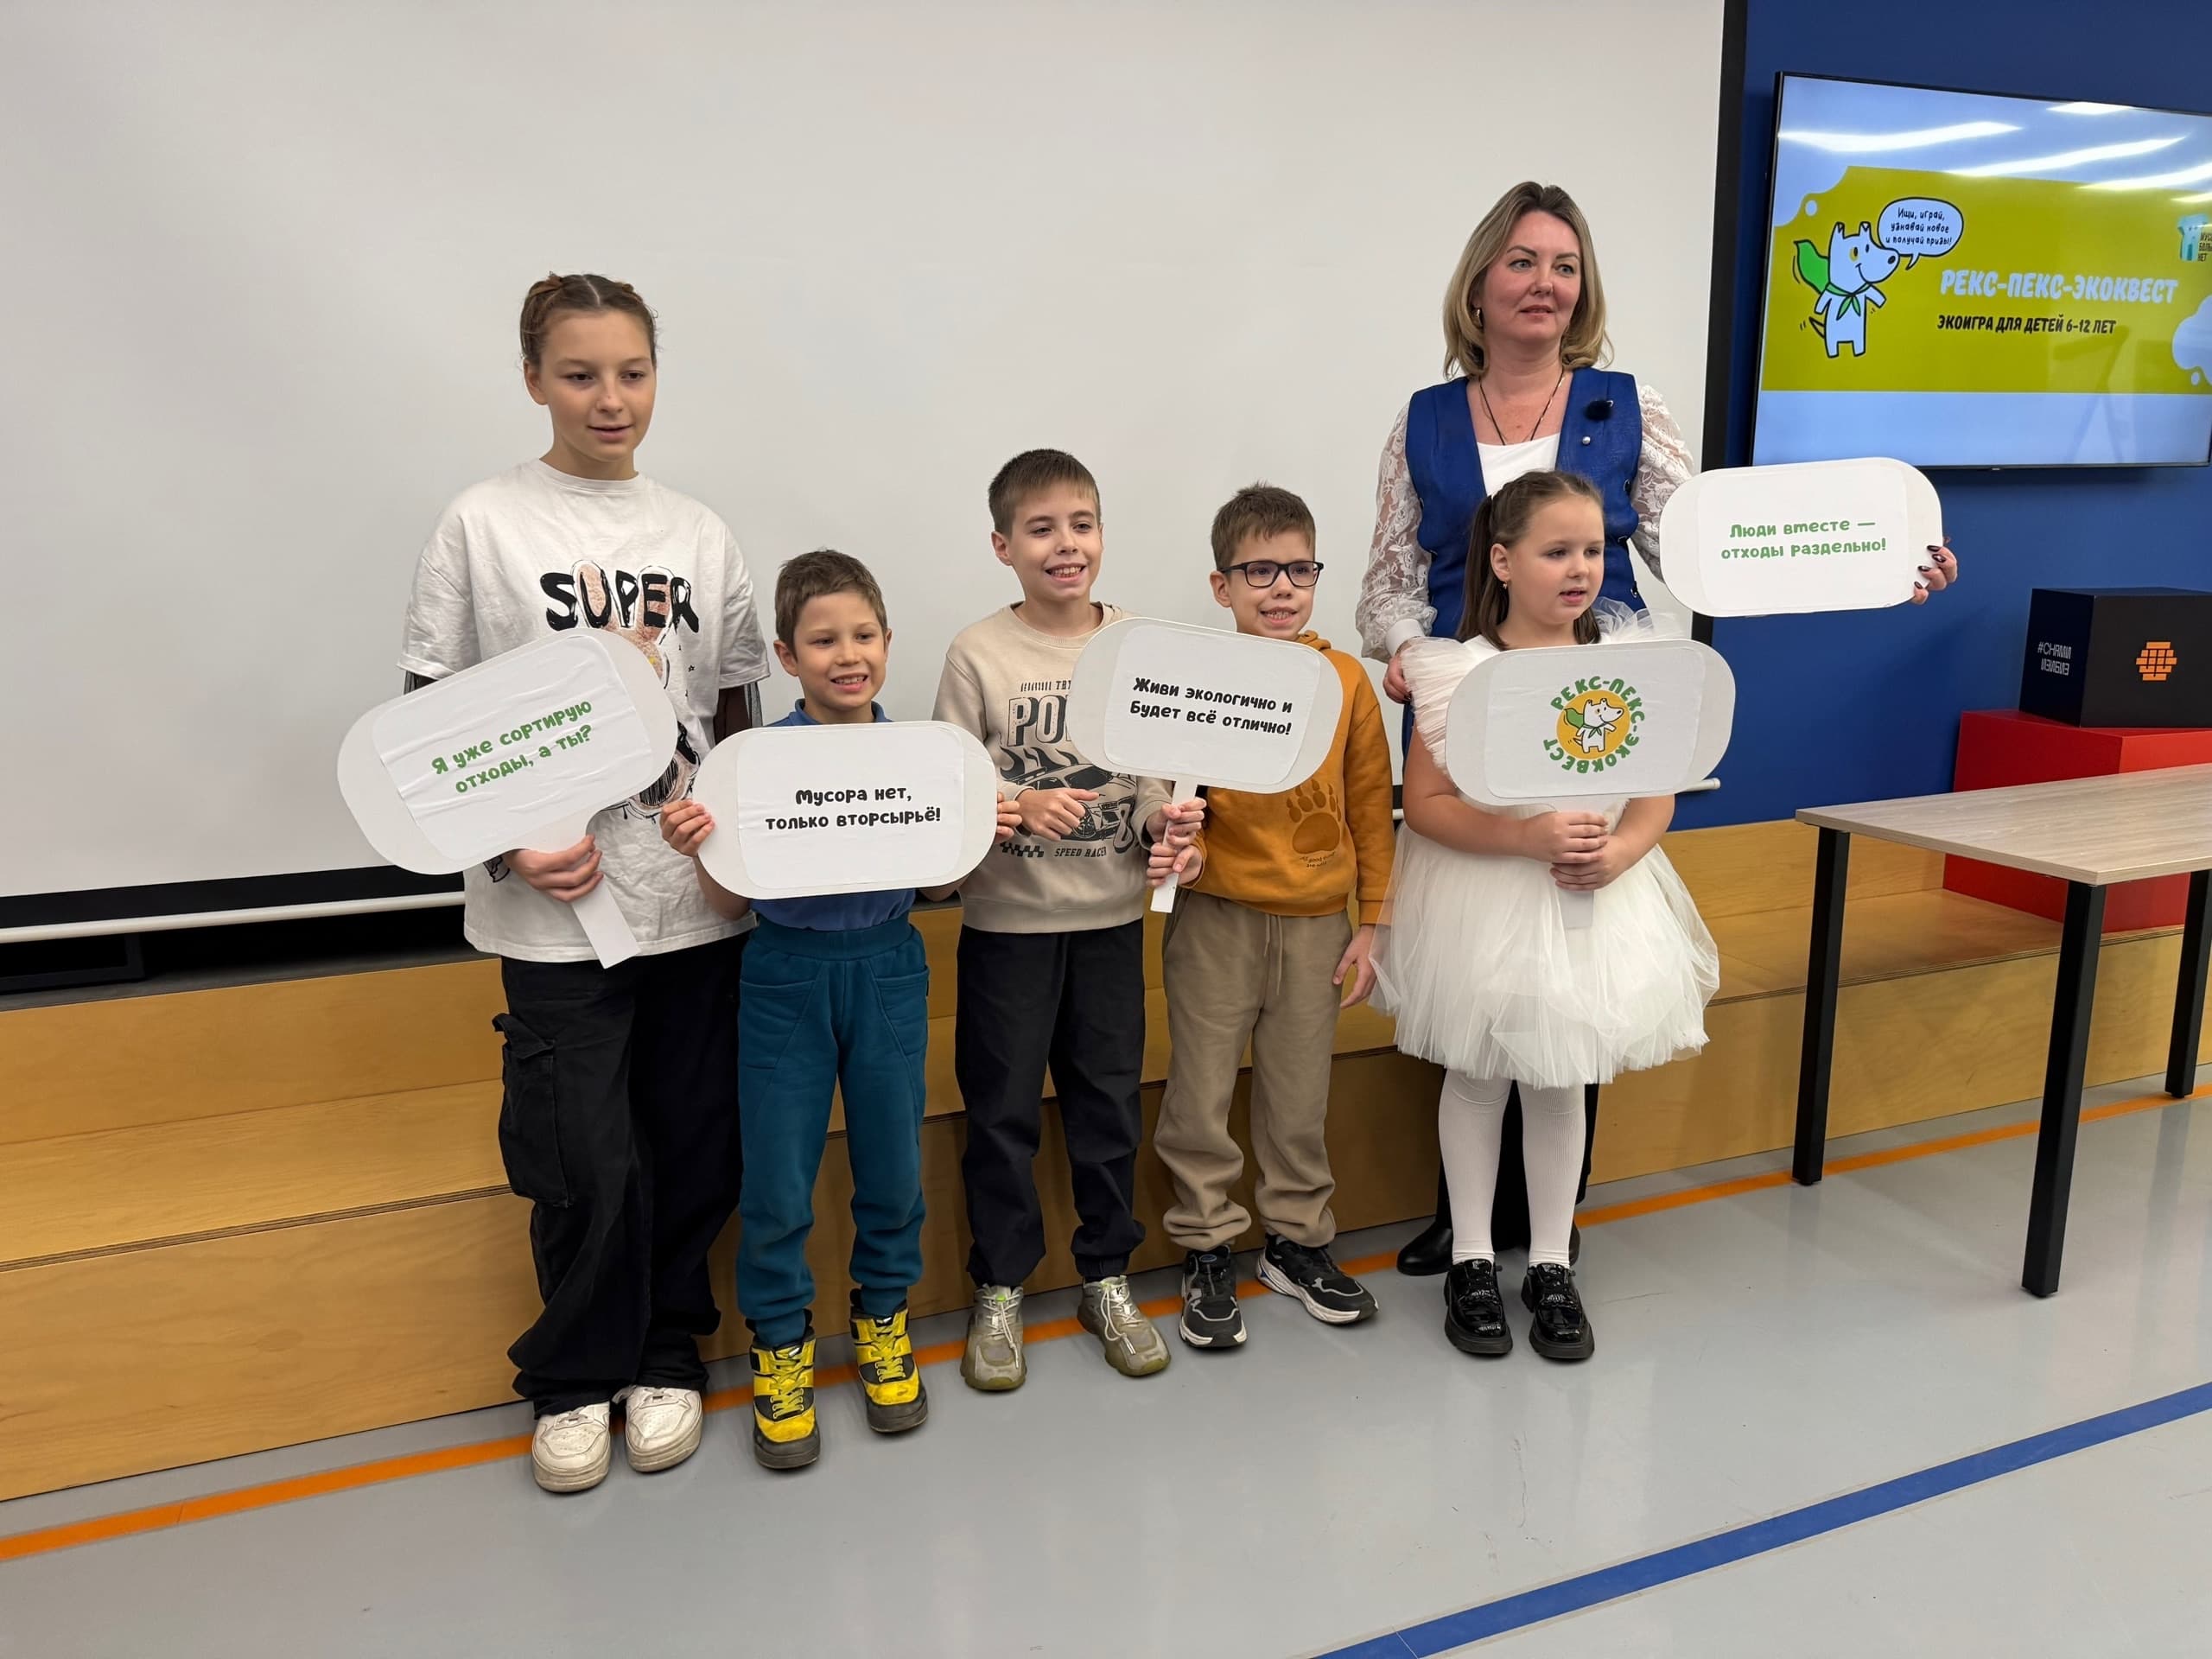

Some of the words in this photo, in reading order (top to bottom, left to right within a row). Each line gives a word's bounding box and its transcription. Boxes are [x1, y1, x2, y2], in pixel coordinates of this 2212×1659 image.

[1897, 207, 1916, 219] Ищи,
[1920, 210, 1945, 221] играй,
[1891, 222, 1924, 232] узнавай
[1927, 223, 1949, 233] новое
[1892, 236, 1924, 245] получай
[1926, 237, 1953, 246] призы!
[1940, 269, 2178, 303] РЕКС-ПЕКС-ЭКОКВЕСТ
[1937, 315, 1993, 331] ЭКОИГРА
[1995, 317, 2022, 334] ДЛЯ
[2024, 314, 2063, 334] ДЕТЕЙ
[2066, 319, 2089, 334] 6-12
[2092, 320, 2117, 334] ЛЕТ
[1729, 524, 1777, 538] Люди
[1783, 520, 1850, 535] вместе
[1721, 545, 1783, 559] отходы
[1790, 537, 1886, 557] раздельно!
[539, 568, 699, 633] SUPER
[1133, 677, 1179, 697] Живи
[1185, 688, 1276, 711] экологично
[1282, 702, 1293, 714] и
[1007, 695, 1071, 747] PO
[1130, 701, 1181, 719] Будет
[1186, 709, 1217, 724] всё
[1222, 715, 1292, 735] отлично!
[431, 757, 448, 775] Я
[452, 740, 493, 768] уже
[499, 701, 592, 746] сортирую
[455, 754, 534, 793] отходы,
[538, 746, 552, 758] а
[556, 724, 592, 750] ты?
[795, 789, 868, 806] Мусора
[874, 787, 912, 802] нет,
[766, 816, 829, 830] только
[836, 806, 941, 827] вторсырьё!
[1054, 847, 1081, 857] SPEED
[1083, 846, 1107, 858] RACER
